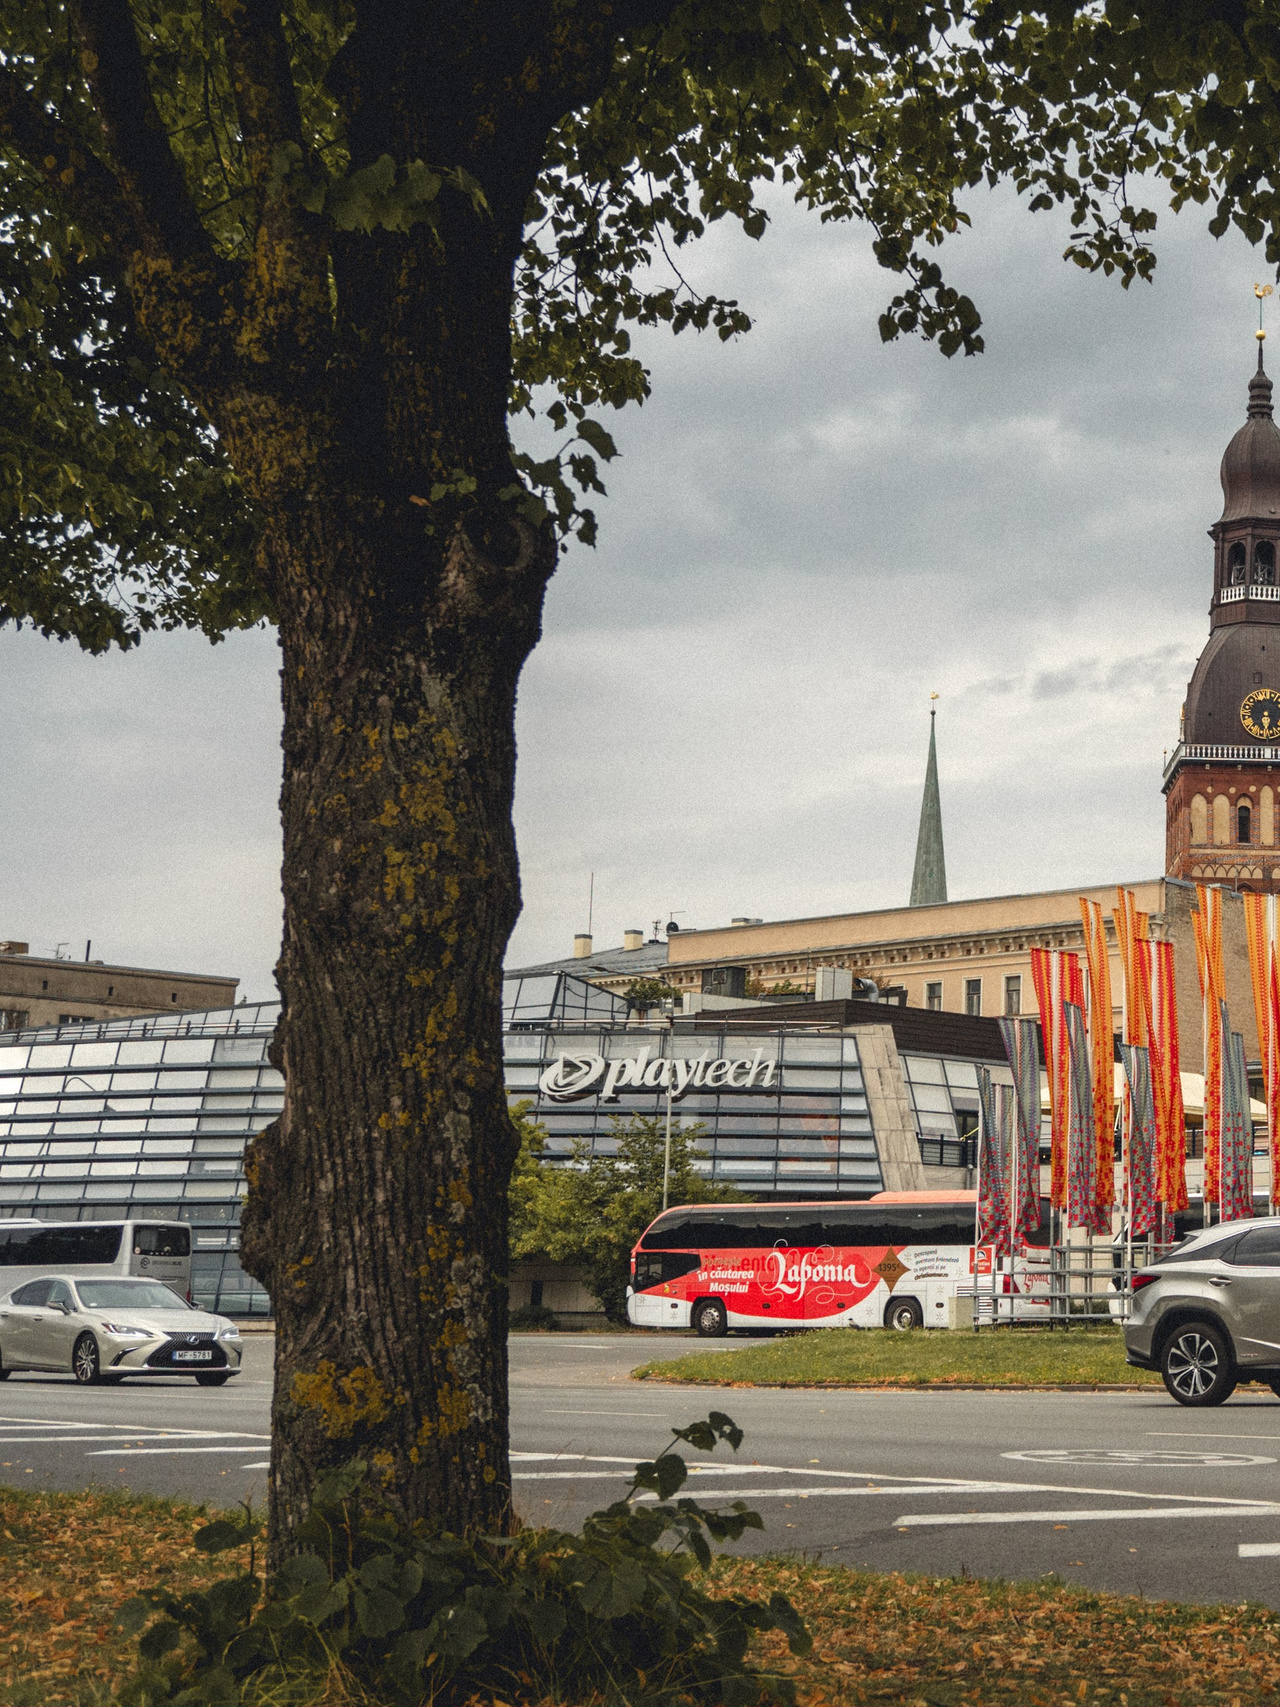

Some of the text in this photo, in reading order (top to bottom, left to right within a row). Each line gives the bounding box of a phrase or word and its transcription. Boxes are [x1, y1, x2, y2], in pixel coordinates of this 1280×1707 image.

[599, 1046, 776, 1097] playtech
[710, 1267, 754, 1279] căutarea
[764, 1246, 872, 1302] Laponia
[709, 1282, 749, 1296] Moșului
[177, 1350, 211, 1359] MF-5781
